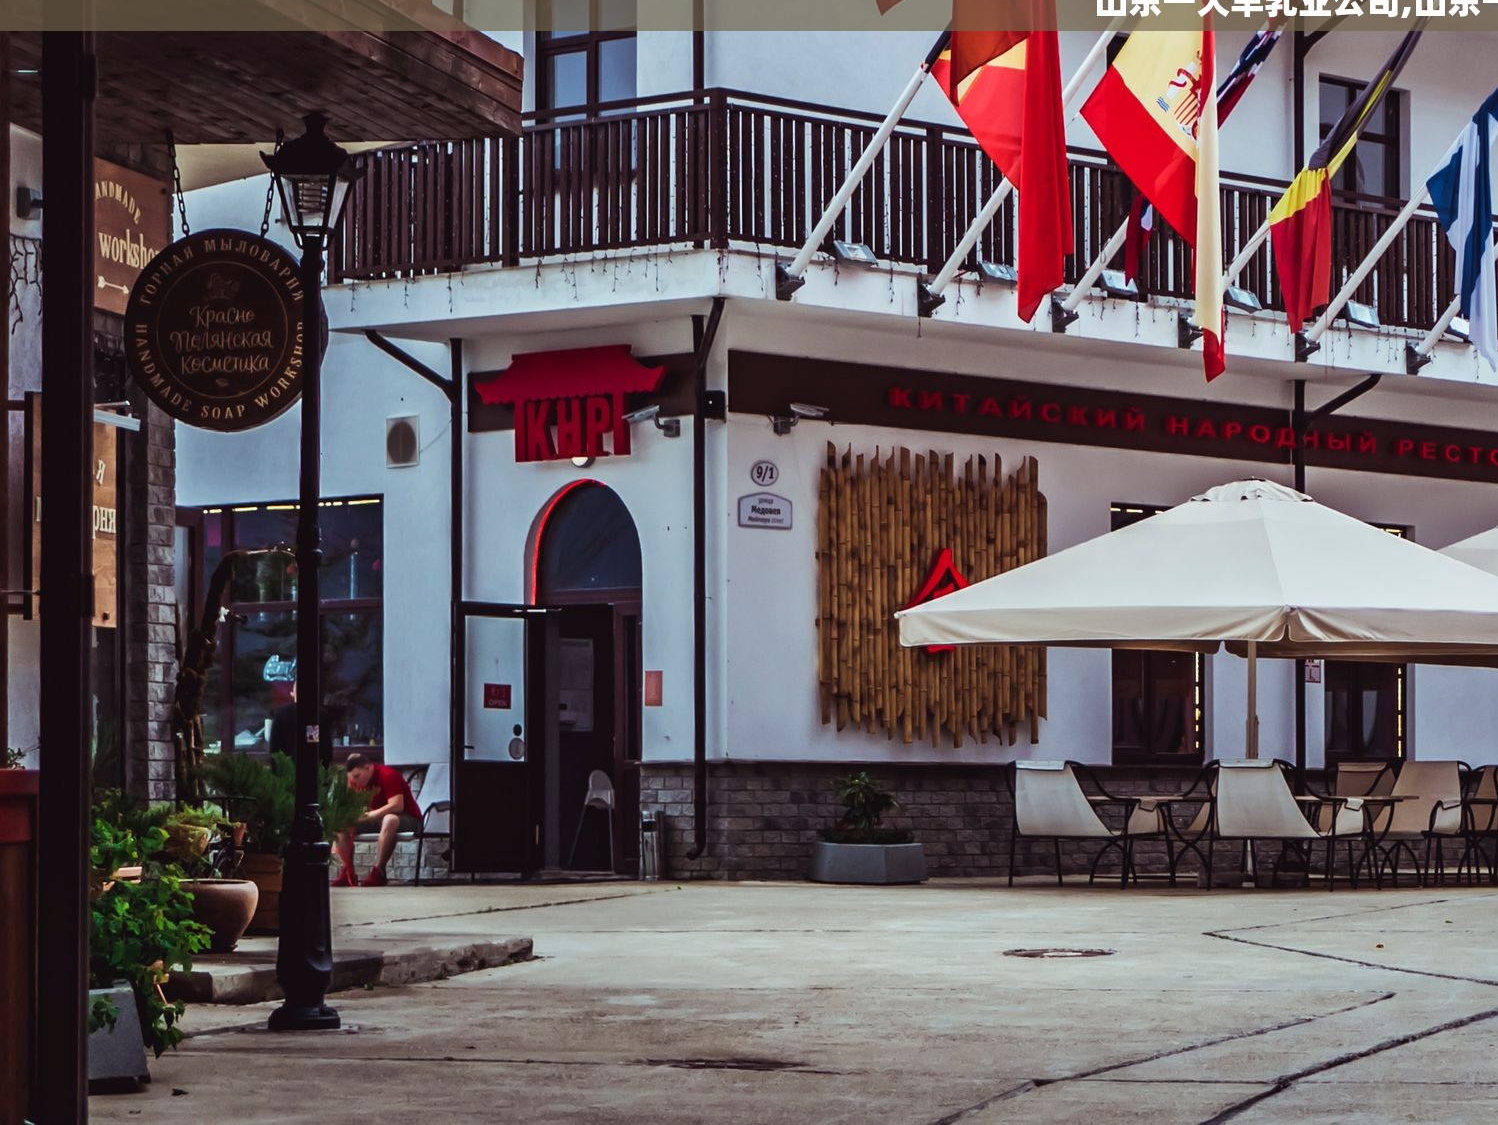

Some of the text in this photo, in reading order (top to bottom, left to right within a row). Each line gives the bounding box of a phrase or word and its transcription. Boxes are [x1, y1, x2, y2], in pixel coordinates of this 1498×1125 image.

[95, 180, 141, 225] ANDMADE
[98, 228, 160, 270] worksho
[139, 246, 195, 306] ГОРНАЯ
[135, 324, 193, 413] HANDMADE
[200, 403, 246, 420] SOAP
[888, 386, 1146, 433] КИТАЙСКИЙ
[1168, 414, 1377, 454] НАРОДНЫЙ
[756, 465, 775, 482] 9/1
